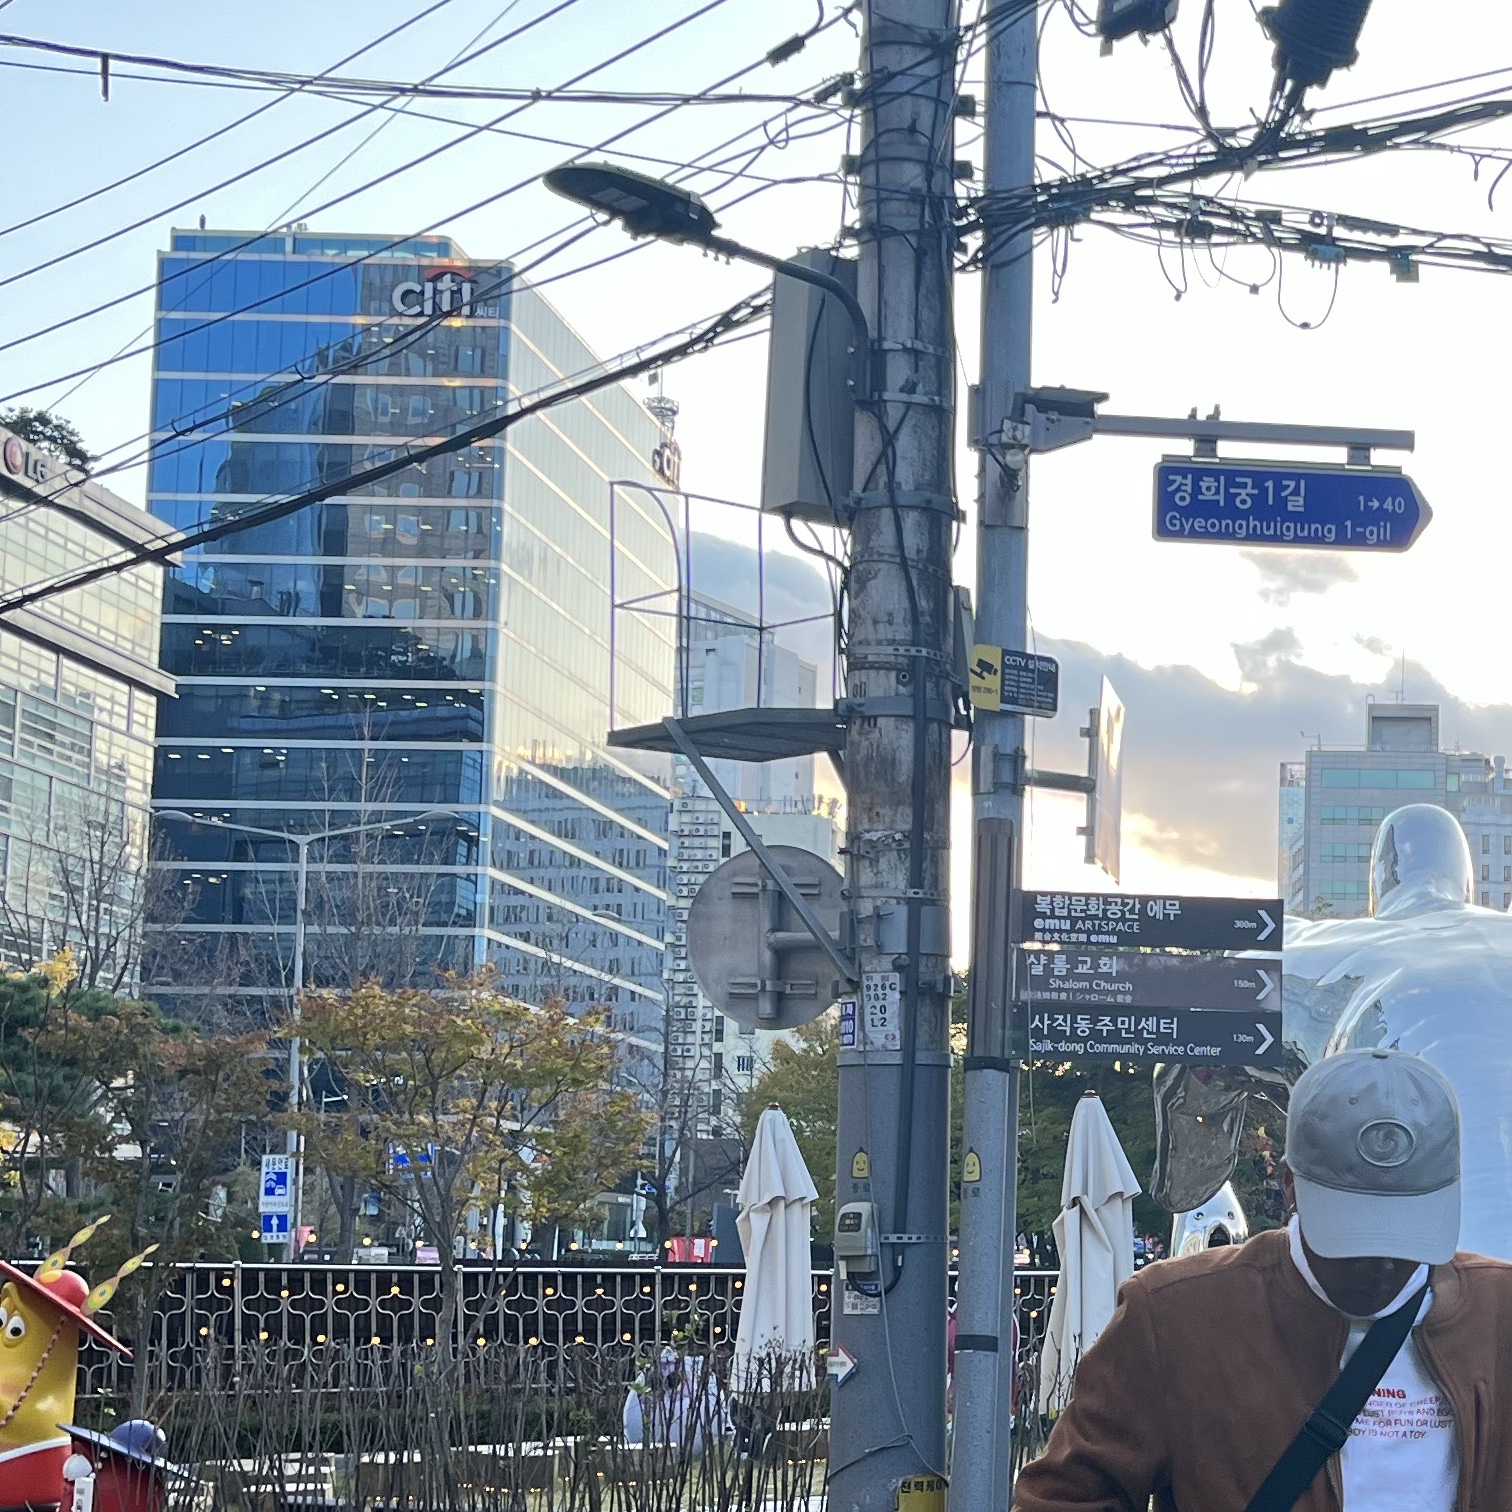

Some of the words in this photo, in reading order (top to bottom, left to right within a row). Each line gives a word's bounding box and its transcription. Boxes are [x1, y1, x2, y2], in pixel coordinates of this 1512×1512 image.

[392, 273, 471, 317] citi
[24, 451, 48, 484] LG
[1166, 473, 1306, 513] 경희궁1길
[1165, 512, 1337, 542] Gyeonghuigung
[1345, 520, 1392, 545] 1-gil
[1004, 655, 1027, 667] CCTV
[1034, 894, 1141, 919] 복합문화공간
[1146, 899, 1182, 921] 에무
[1033, 918, 1071, 931] emu
[1075, 920, 1141, 934] ARTSPACE
[1233, 919, 1258, 930] 300m
[1090, 934, 1118, 944] emu
[1048, 977, 1090, 990] Shalom
[1092, 979, 1133, 992] Church
[1029, 1013, 1179, 1040] 사직동주민센터
[1029, 1038, 1084, 1055] Sajik-dong
[1086, 1040, 1145, 1057] Community
[1147, 1042, 1185, 1057] Service
[1186, 1043, 1222, 1057] Center
[1394, 1418, 1414, 1428] FUN
